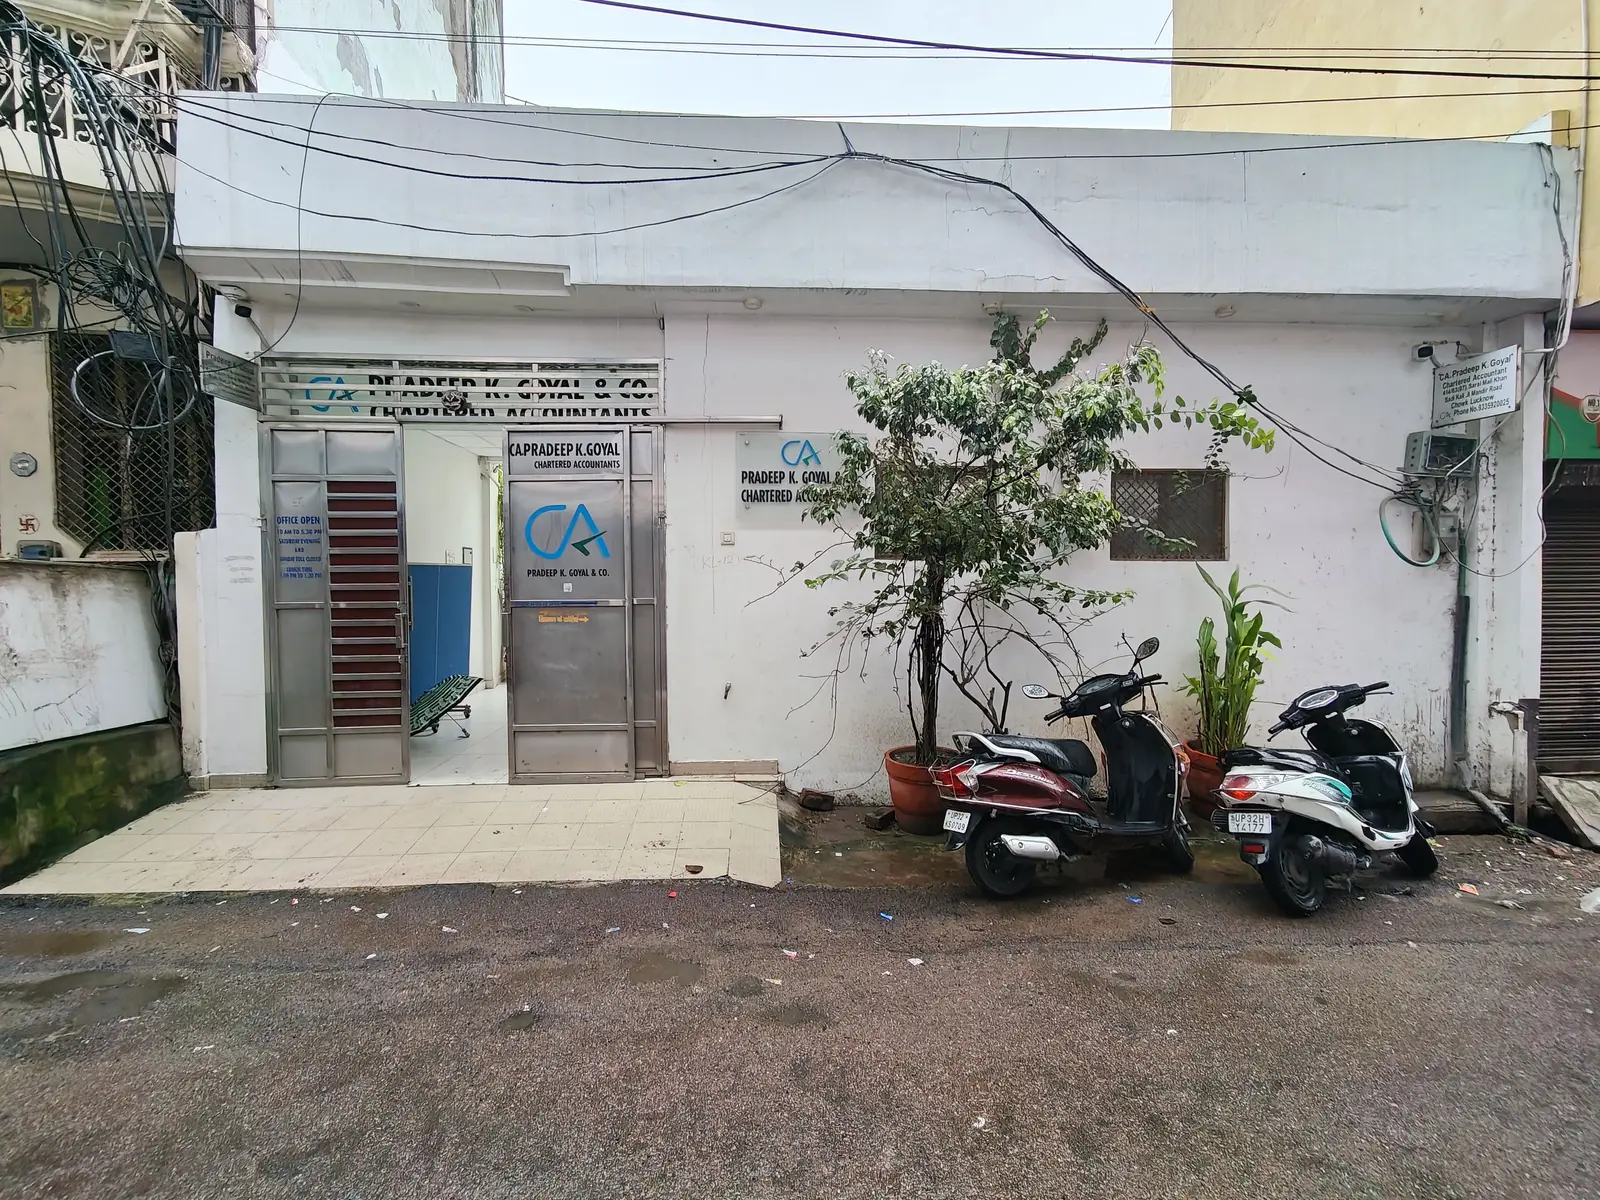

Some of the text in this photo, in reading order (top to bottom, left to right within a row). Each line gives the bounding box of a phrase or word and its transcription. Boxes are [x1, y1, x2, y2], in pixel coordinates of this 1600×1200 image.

[1442, 367, 1507, 389] Chartered Accountant
[517, 378, 585, 400] GOYAL
[594, 378, 612, 400] &
[619, 378, 654, 400] CO.
[1489, 384, 1503, 392] Road
[1470, 394, 1495, 405] Lucknow
[1453, 407, 1469, 416] Phone
[781, 440, 822, 467] CA
[534, 460, 621, 469] CHARTERED ACCOUNTANTS
[741, 470, 786, 485] PRADEEP
[788, 470, 799, 485] K.
[802, 470, 832, 485] GOYAL
[741, 489, 793, 503] CHARTERED
[276, 516, 320, 525] OFFICE OPEN
[525, 503, 611, 560] CA
[527, 568, 610, 577] PRADEEP K. GOYAL & CO.
[1235, 814, 1265, 824] UP32H
[1235, 823, 1265, 832] Y4177
